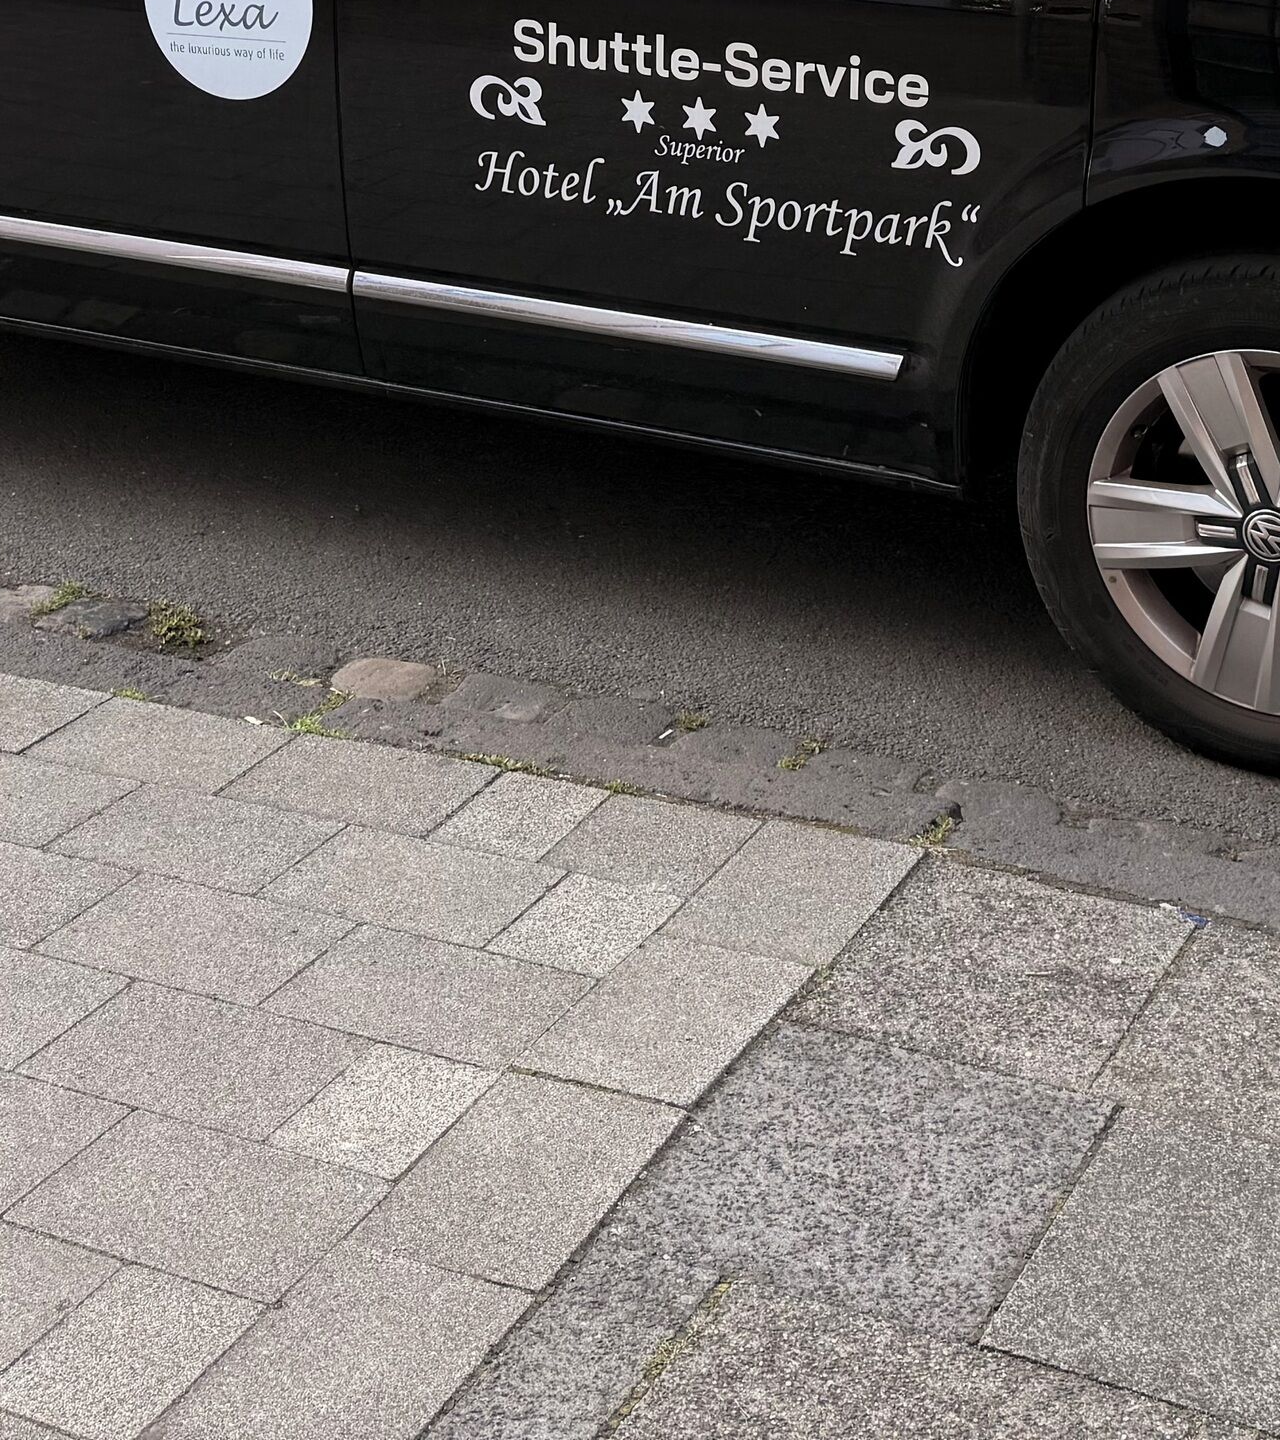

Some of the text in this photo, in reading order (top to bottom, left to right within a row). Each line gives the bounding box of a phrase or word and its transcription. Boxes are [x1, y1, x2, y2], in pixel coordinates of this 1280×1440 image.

[170, 41, 285, 61] the luxurious way of life
[513, 18, 930, 109] Shuttle-Service
[654, 134, 746, 165] Superior
[474, 150, 982, 267] Hotel „Am Sportpark“
